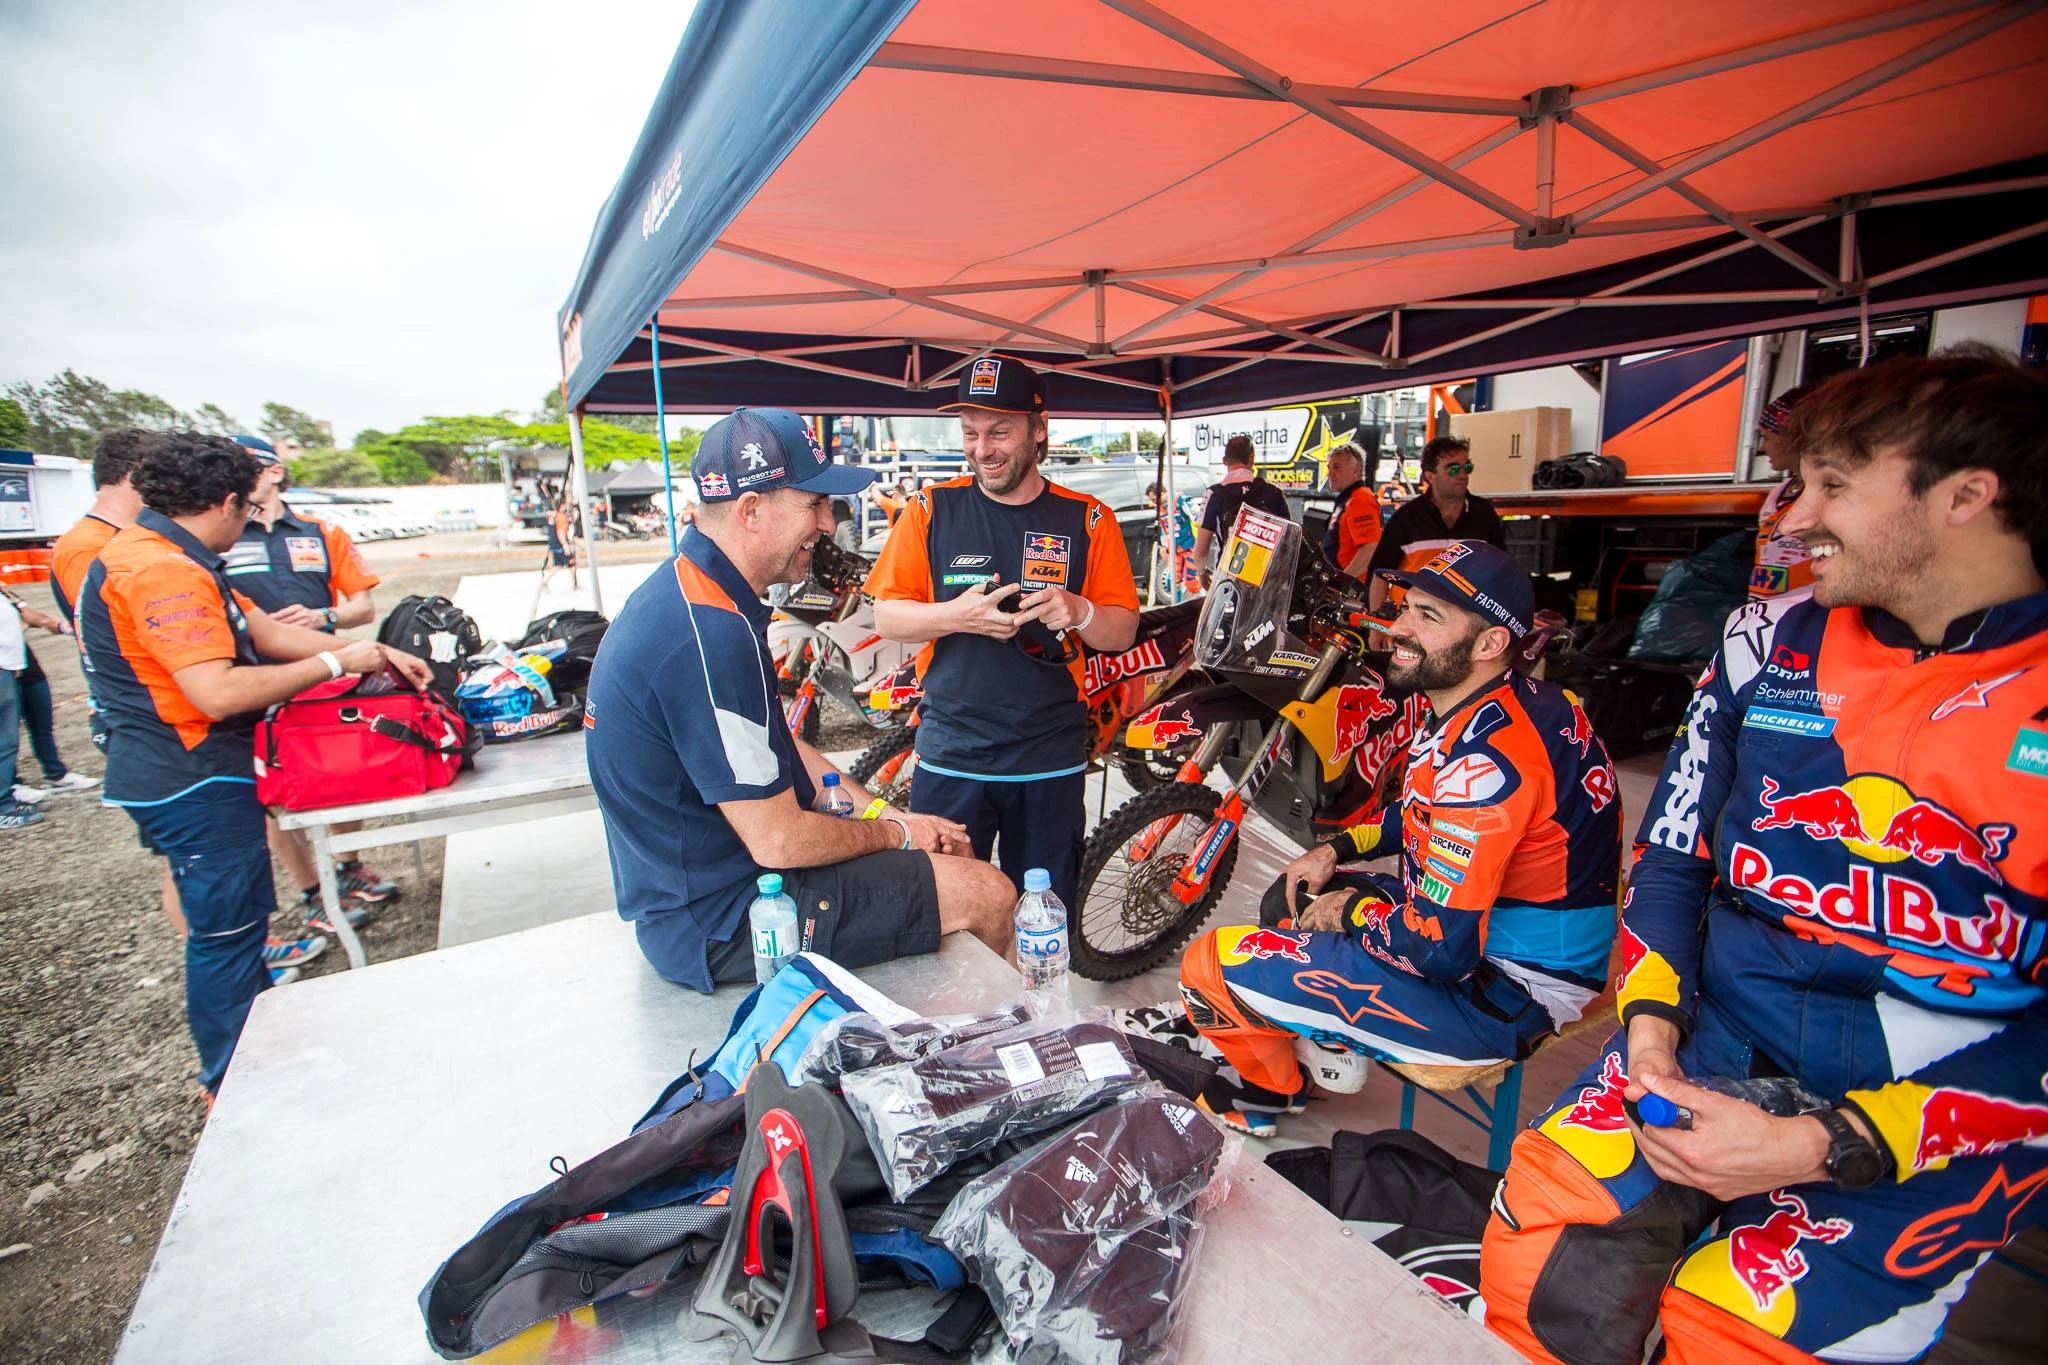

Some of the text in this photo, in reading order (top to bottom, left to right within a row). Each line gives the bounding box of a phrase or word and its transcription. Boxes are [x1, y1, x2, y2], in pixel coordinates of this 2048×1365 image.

[737, 466, 785, 483] PEUGEOT SPORT
[716, 484, 731, 495] Bull
[1242, 522, 1277, 542] MOTUL
[955, 557, 986, 565] WP
[1025, 547, 1068, 563] Red Bull
[1229, 541, 1249, 574] 8
[1031, 565, 1061, 578] KTM
[1024, 581, 1045, 589] FACTORY
[1475, 592, 1528, 639] FACTORY RACING
[1243, 620, 1275, 651] KTM
[1098, 638, 1166, 688] Bull
[1253, 665, 1269, 674] TOBY
[1269, 667, 1287, 676] PRICE
[1756, 682, 1845, 706] Schlemmer
[492, 710, 557, 737] Red Bull
[1751, 712, 1826, 732] MICHELIN
[1355, 694, 1415, 790] Red
[1200, 822, 1230, 869] MICHELIN
[1730, 842, 1877, 933] Red
[1161, 1102, 1187, 1136] adidas
